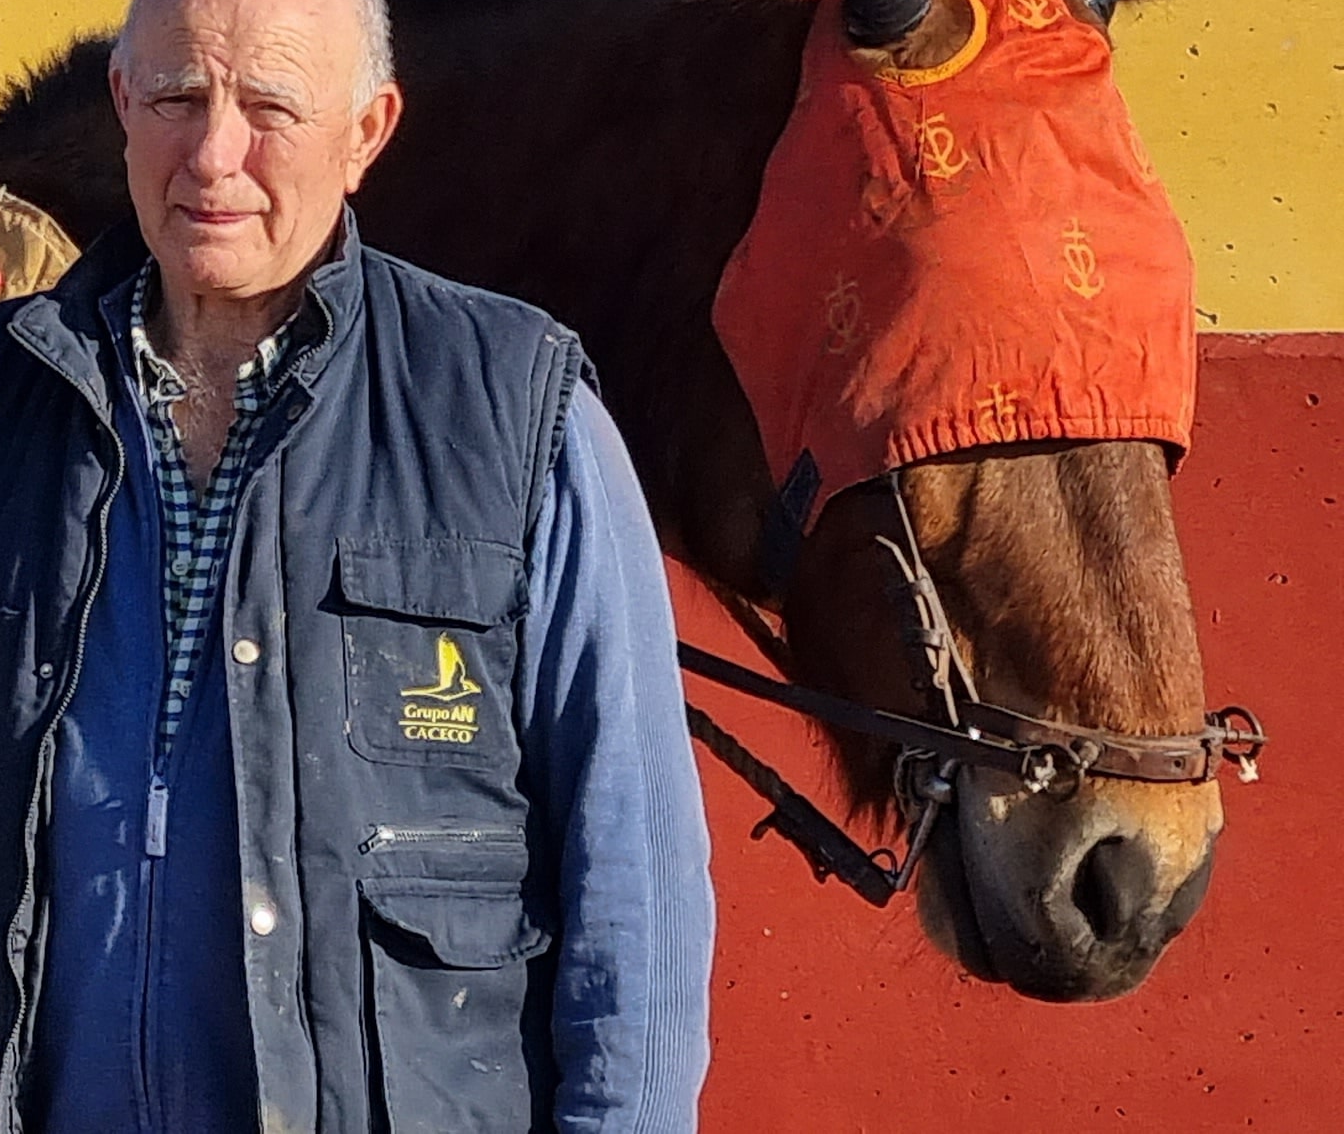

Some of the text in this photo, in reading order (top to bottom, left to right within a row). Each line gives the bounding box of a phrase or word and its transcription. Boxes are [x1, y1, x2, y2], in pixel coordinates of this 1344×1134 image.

[404, 703, 475, 723] Grupo AN
[404, 726, 473, 743] CACECO
